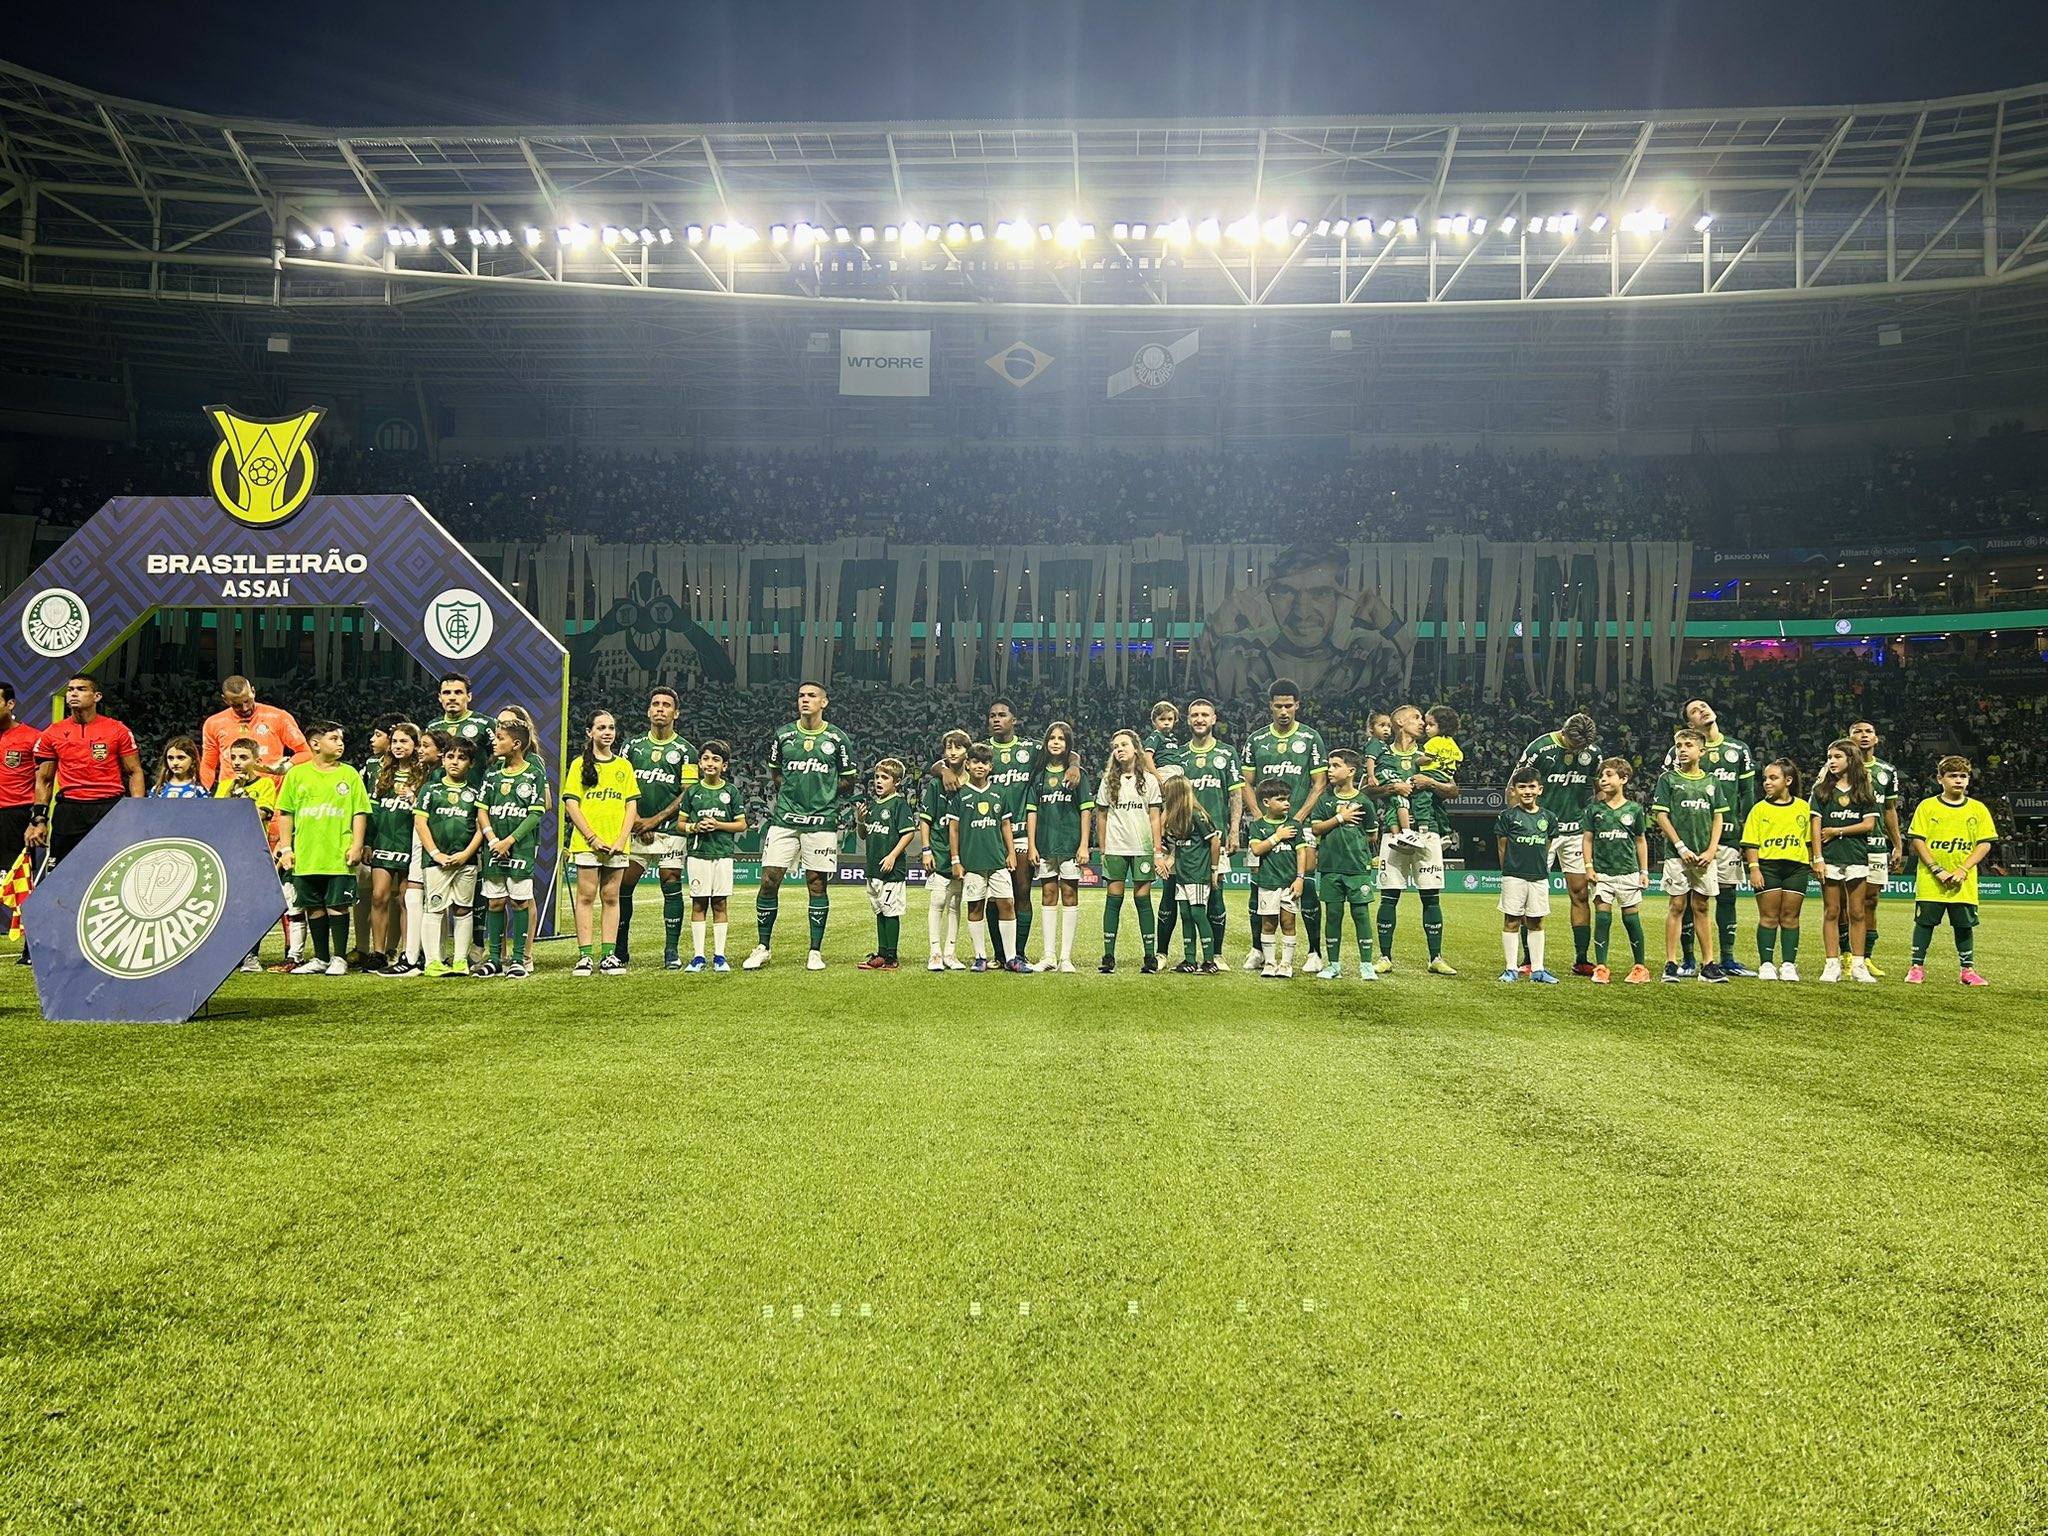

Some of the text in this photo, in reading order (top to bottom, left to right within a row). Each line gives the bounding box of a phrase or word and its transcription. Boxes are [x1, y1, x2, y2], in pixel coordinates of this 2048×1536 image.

[847, 355, 924, 369] WTORRE
[1136, 361, 1173, 387] PALMEIRAS
[1987, 538, 2021, 549] Allianz
[1724, 553, 1750, 561] BANCO
[1839, 546, 1917, 558] Allianz Seguros
[147, 548, 368, 574] BRASILEIRÃO
[221, 577, 290, 598] ASSAÍ
[29, 617, 83, 652] PALMEIRAS
[787, 758, 829, 774] crefisa
[1262, 761, 1303, 777] crefisa
[988, 769, 1030, 786] crefisa
[1190, 774, 1221, 790] refisa
[1548, 770, 1587, 786] crefisa
[586, 788, 622, 802] crefisa
[300, 803, 345, 821] crefisa
[436, 806, 468, 818] crefisa
[490, 802, 528, 819] crefisa
[697, 807, 726, 818] crefisa
[1830, 810, 1860, 820] crefisa
[1558, 822, 1580, 832] am
[1516, 836, 1546, 846] crefisa
[1599, 830, 1628, 840] crefisa
[1867, 836, 1886, 846] am
[2008, 882, 2044, 895] LOJA
[884, 890, 891, 902] 7
[86, 895, 215, 970] PALMEIRAS
